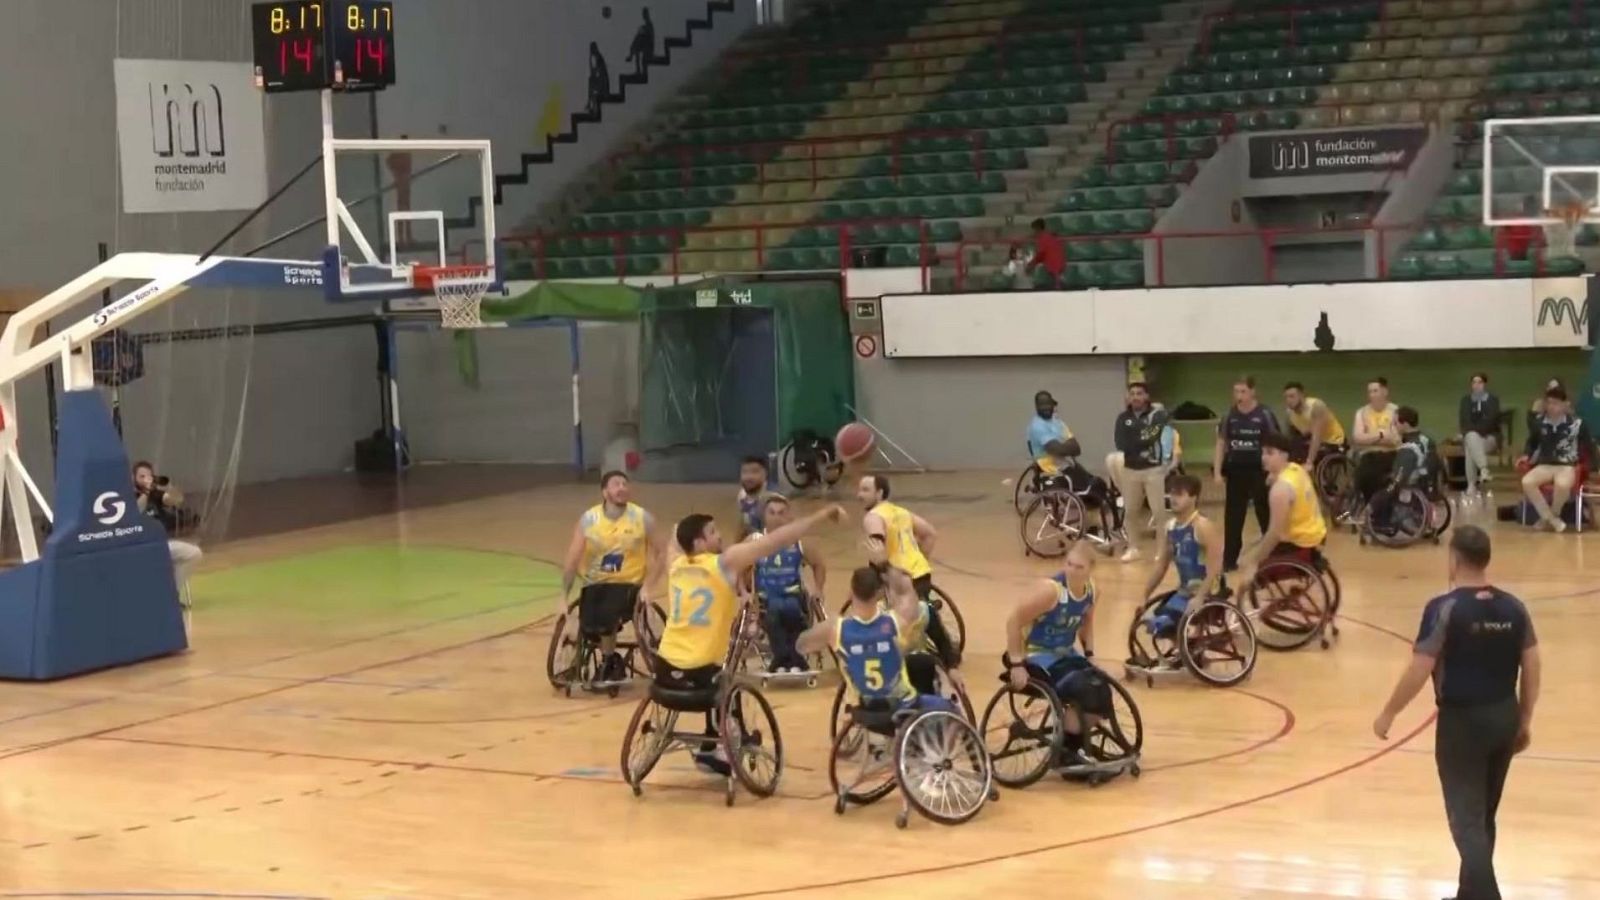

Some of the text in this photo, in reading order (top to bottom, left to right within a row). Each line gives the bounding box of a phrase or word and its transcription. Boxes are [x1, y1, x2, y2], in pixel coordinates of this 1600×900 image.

[270, 4, 321, 34] 8:17
[347, 4, 391, 31] 8:17
[280, 38, 313, 76] 14
[355, 38, 384, 75] 14
[1315, 137, 1376, 152] fundación
[154, 161, 227, 175] montemadrid
[155, 178, 205, 193] fundación
[284, 275, 324, 286] Sports
[114, 525, 143, 537] Sports
[773, 553, 782, 568] 4
[671, 585, 714, 627] 12
[864, 658, 884, 691] 5
